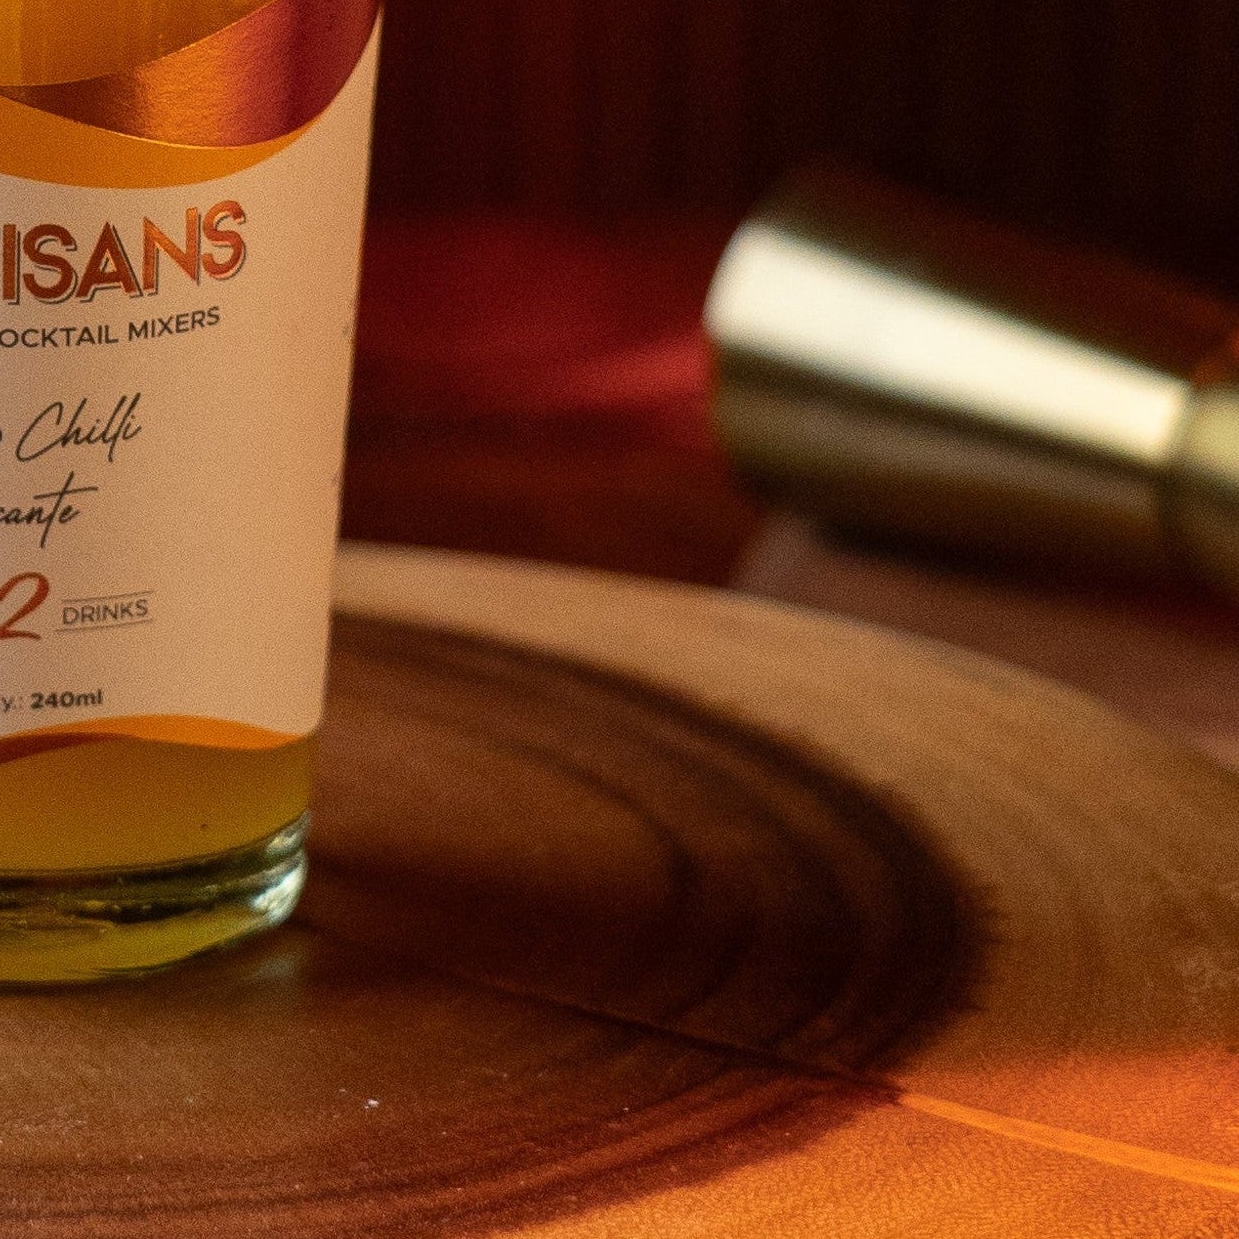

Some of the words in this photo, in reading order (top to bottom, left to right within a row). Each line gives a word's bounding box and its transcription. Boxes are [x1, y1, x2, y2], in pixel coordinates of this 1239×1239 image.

[128, 306, 221, 341] MIXERS
[16, 392, 143, 462] Chilli
[63, 599, 149, 625] DRINKS
[30, 688, 104, 710] 240ml
